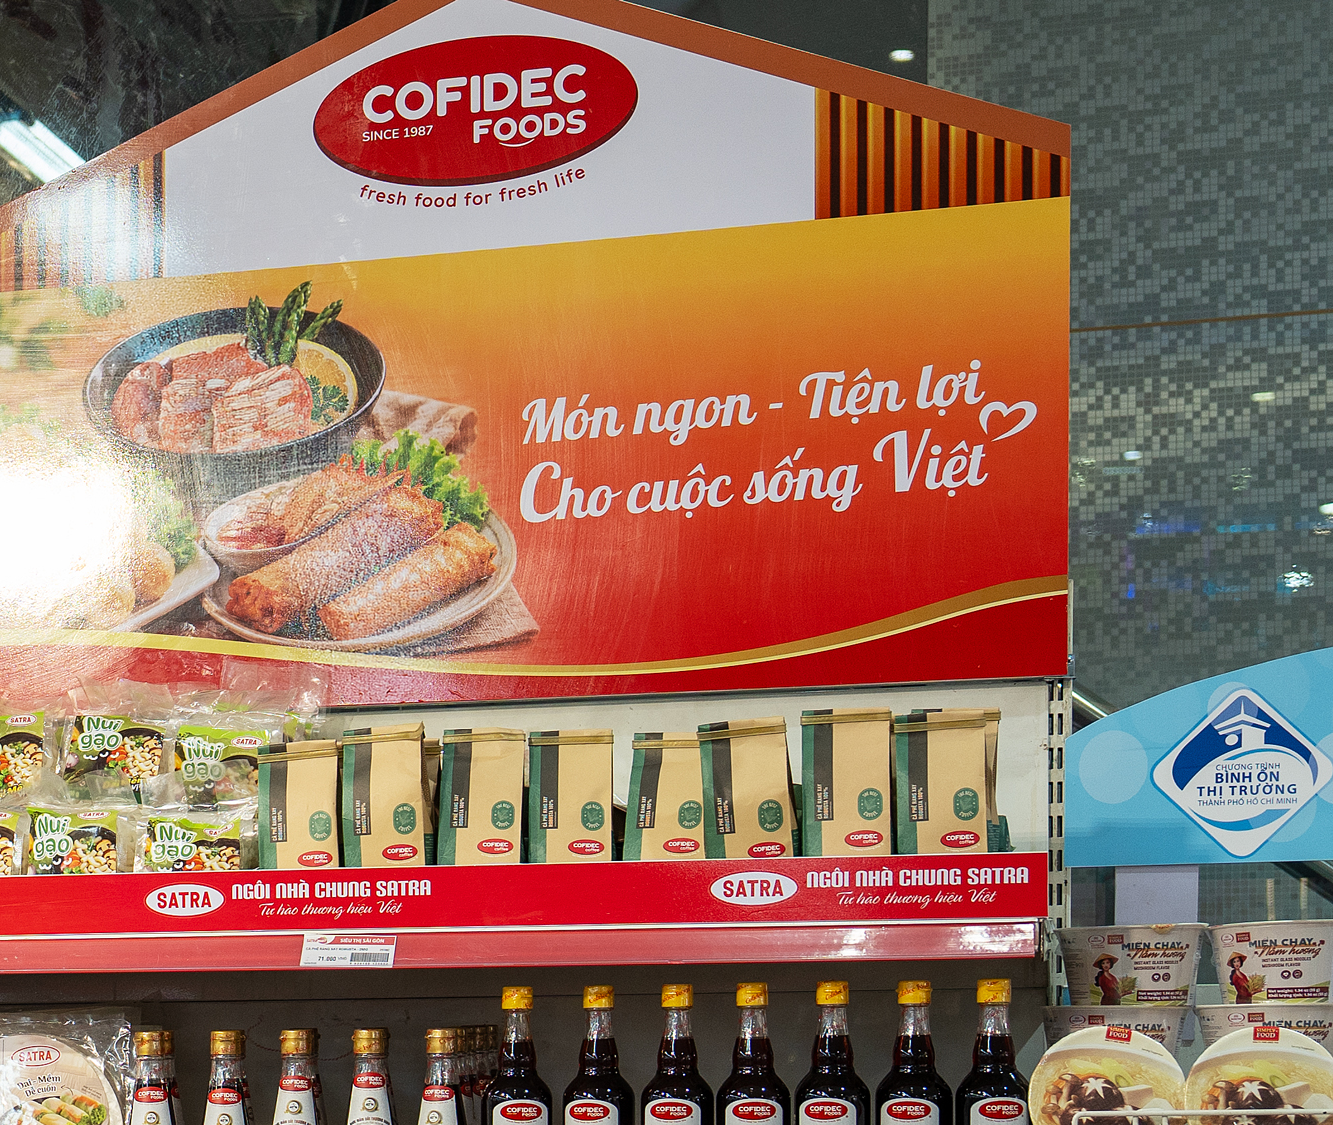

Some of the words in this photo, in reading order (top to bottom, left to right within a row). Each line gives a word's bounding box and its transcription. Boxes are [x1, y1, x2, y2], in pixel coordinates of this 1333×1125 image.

[363, 64, 586, 123] COFIDEC
[362, 128, 399, 142] SINCE
[403, 125, 433, 137] 1987
[473, 110, 586, 144] FOODS
[359, 185, 406, 206] fresh
[415, 193, 456, 208] food
[464, 193, 491, 206] for
[499, 180, 548, 202] fresh
[555, 168, 585, 188] life
[522, 394, 624, 444] Món
[633, 393, 757, 446] ngon
[798, 368, 904, 424] Tiện
[916, 359, 985, 416] lợi
[520, 461, 620, 523] Cho
[627, 463, 734, 519] cuộc
[743, 448, 862, 512] sống
[873, 428, 988, 498] Việt
[1216, 763, 1252, 771] CHƯƠNG
[1256, 762, 1280, 770] TRÌNH
[1216, 770, 1252, 783] BÌNH
[1257, 767, 1279, 782] ỔN
[1197, 786, 1222, 799] THỊ
[1229, 783, 1297, 796] TRƯỜNG
[1198, 798, 1225, 806] THÀNH
